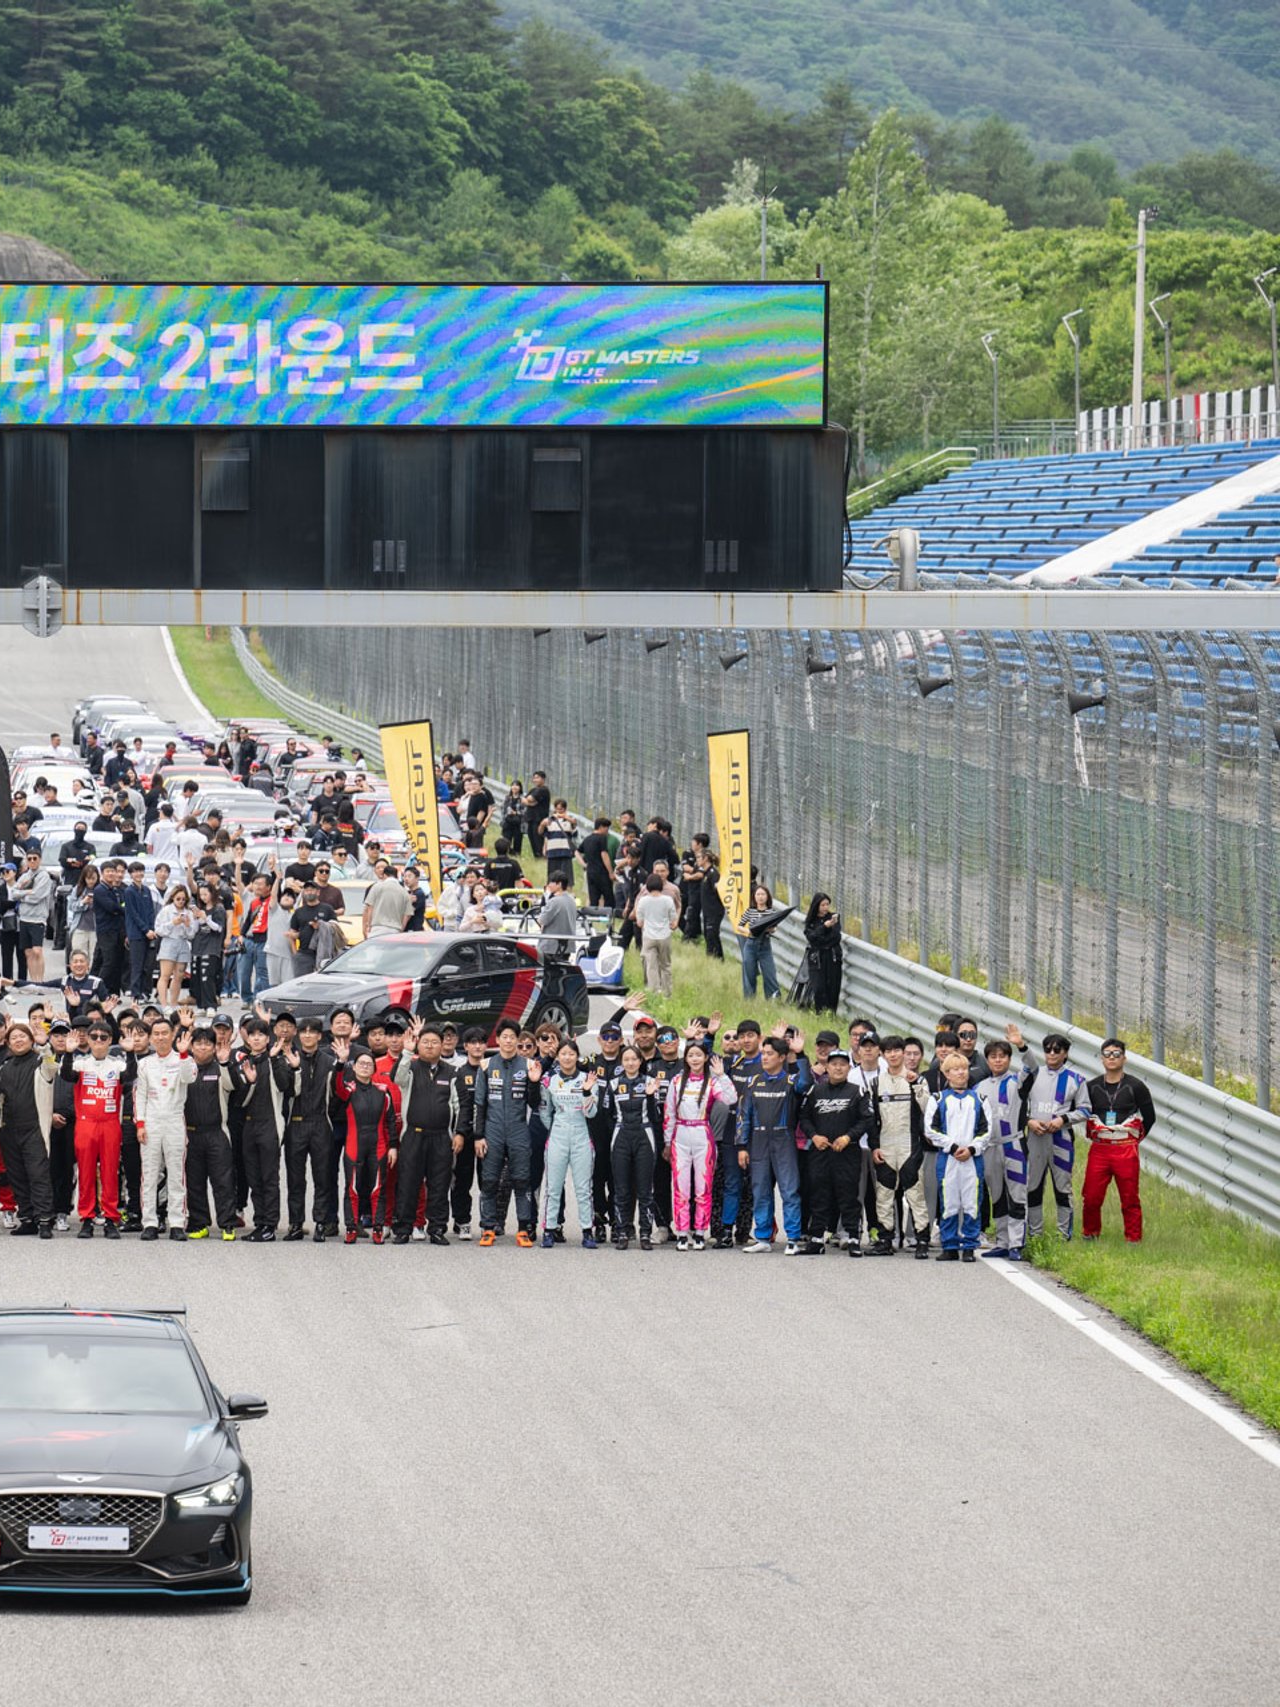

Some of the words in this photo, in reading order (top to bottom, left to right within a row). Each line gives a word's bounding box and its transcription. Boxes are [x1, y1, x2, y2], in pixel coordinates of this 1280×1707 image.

[158, 318, 424, 395] 2라운드
[565, 350, 595, 365] GT
[596, 349, 701, 365] MASTERS
[562, 366, 607, 378] INJE
[433, 999, 492, 1015] SPEEDIUM
